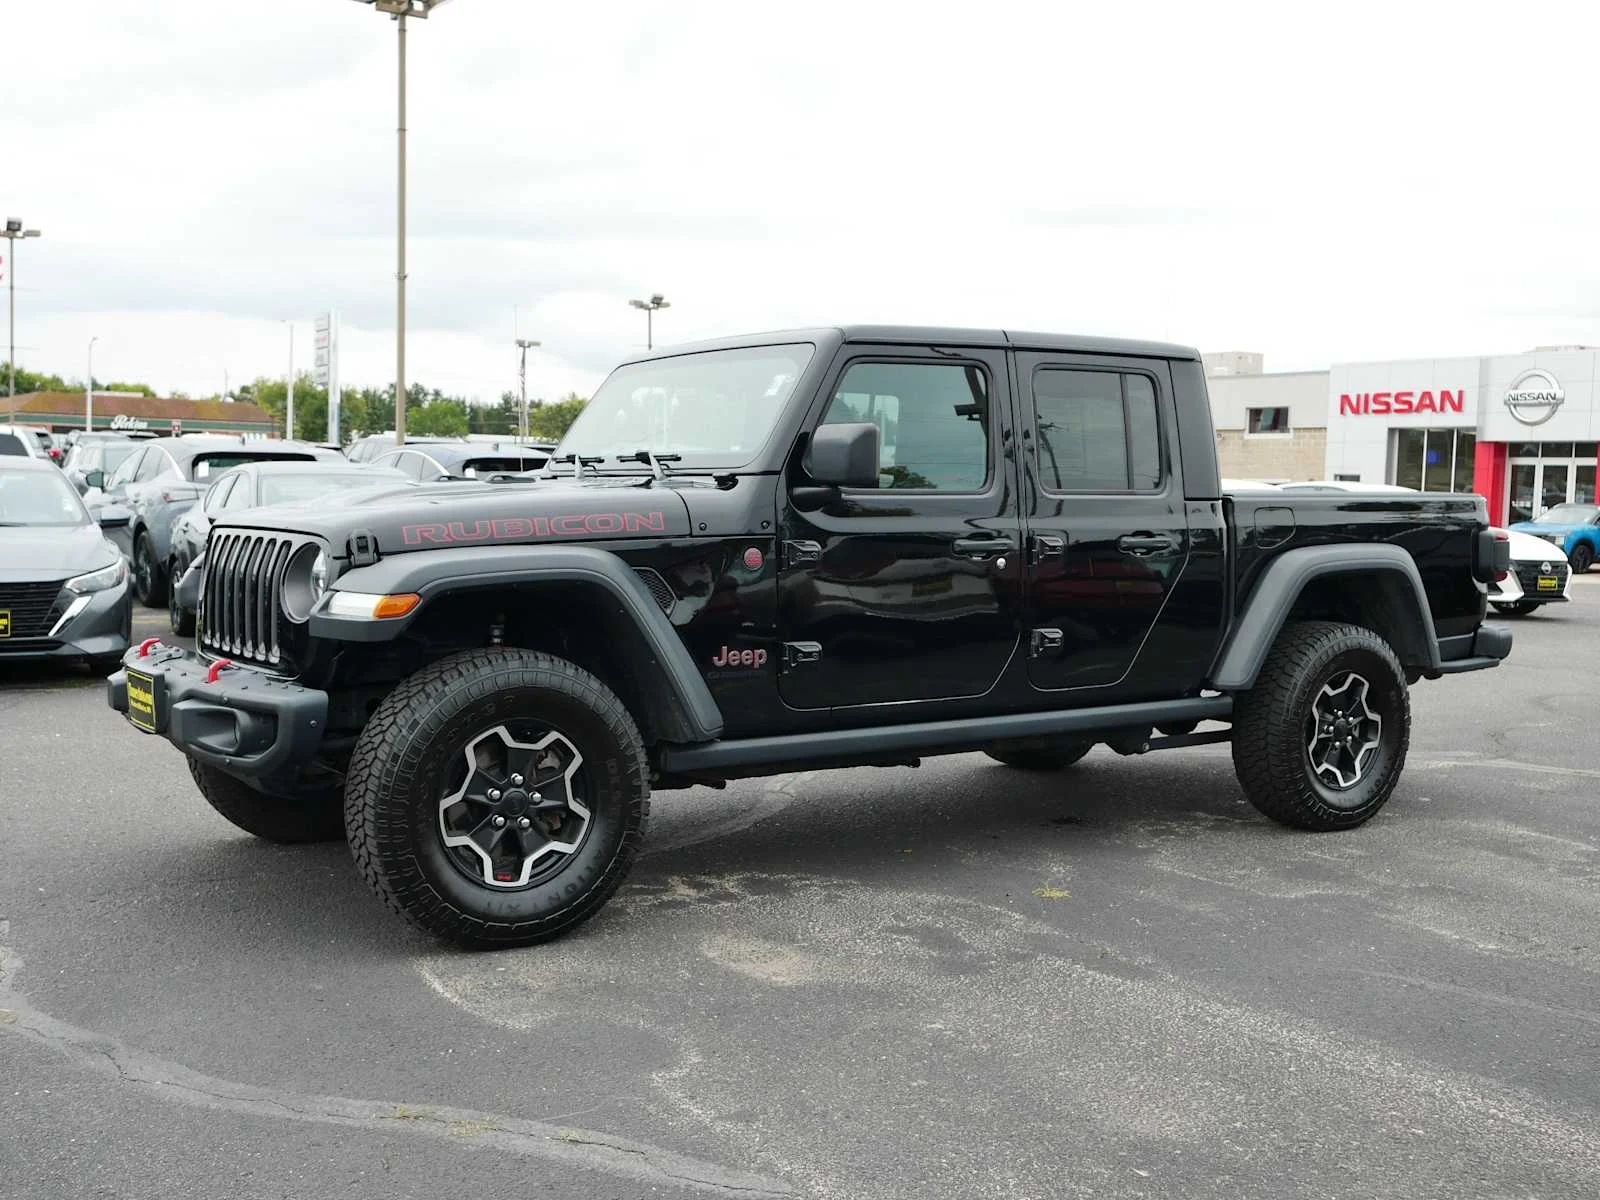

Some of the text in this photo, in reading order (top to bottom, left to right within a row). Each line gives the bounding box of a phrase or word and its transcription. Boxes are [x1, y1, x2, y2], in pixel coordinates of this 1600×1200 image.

[1339, 389, 1464, 416] NISSAN
[1507, 391, 1557, 402] NISSAN
[402, 511, 665, 545] RUBICON
[712, 645, 768, 669] Jeep
